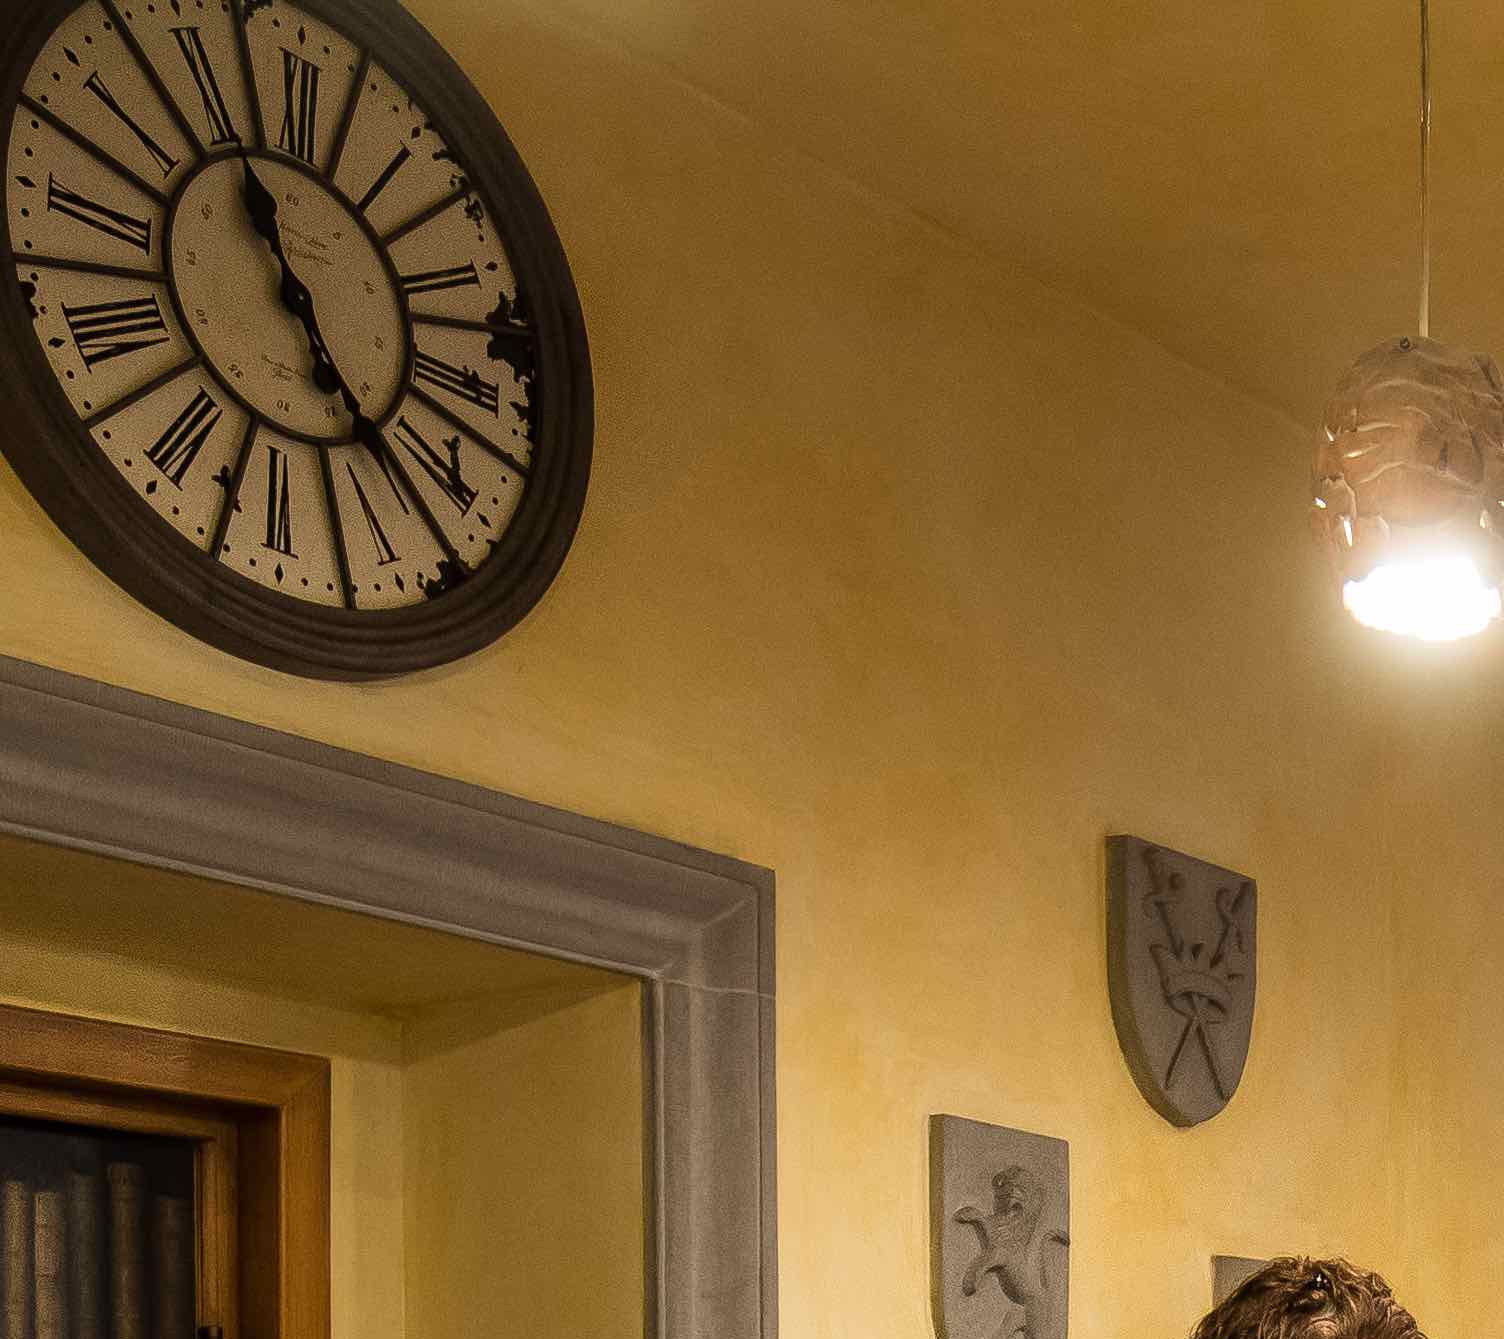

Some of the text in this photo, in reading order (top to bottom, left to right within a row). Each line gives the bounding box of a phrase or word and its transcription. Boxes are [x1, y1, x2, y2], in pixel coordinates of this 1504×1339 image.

[83, 70, 180, 179] X
[168, 26, 241, 146] XI
[274, 46, 321, 168] XII
[47, 171, 151, 256] IX
[399, 259, 482, 297] II
[61, 293, 170, 374] VIII
[413, 345, 499, 419] III
[143, 385, 223, 491] VII
[260, 445, 299, 560] VI
